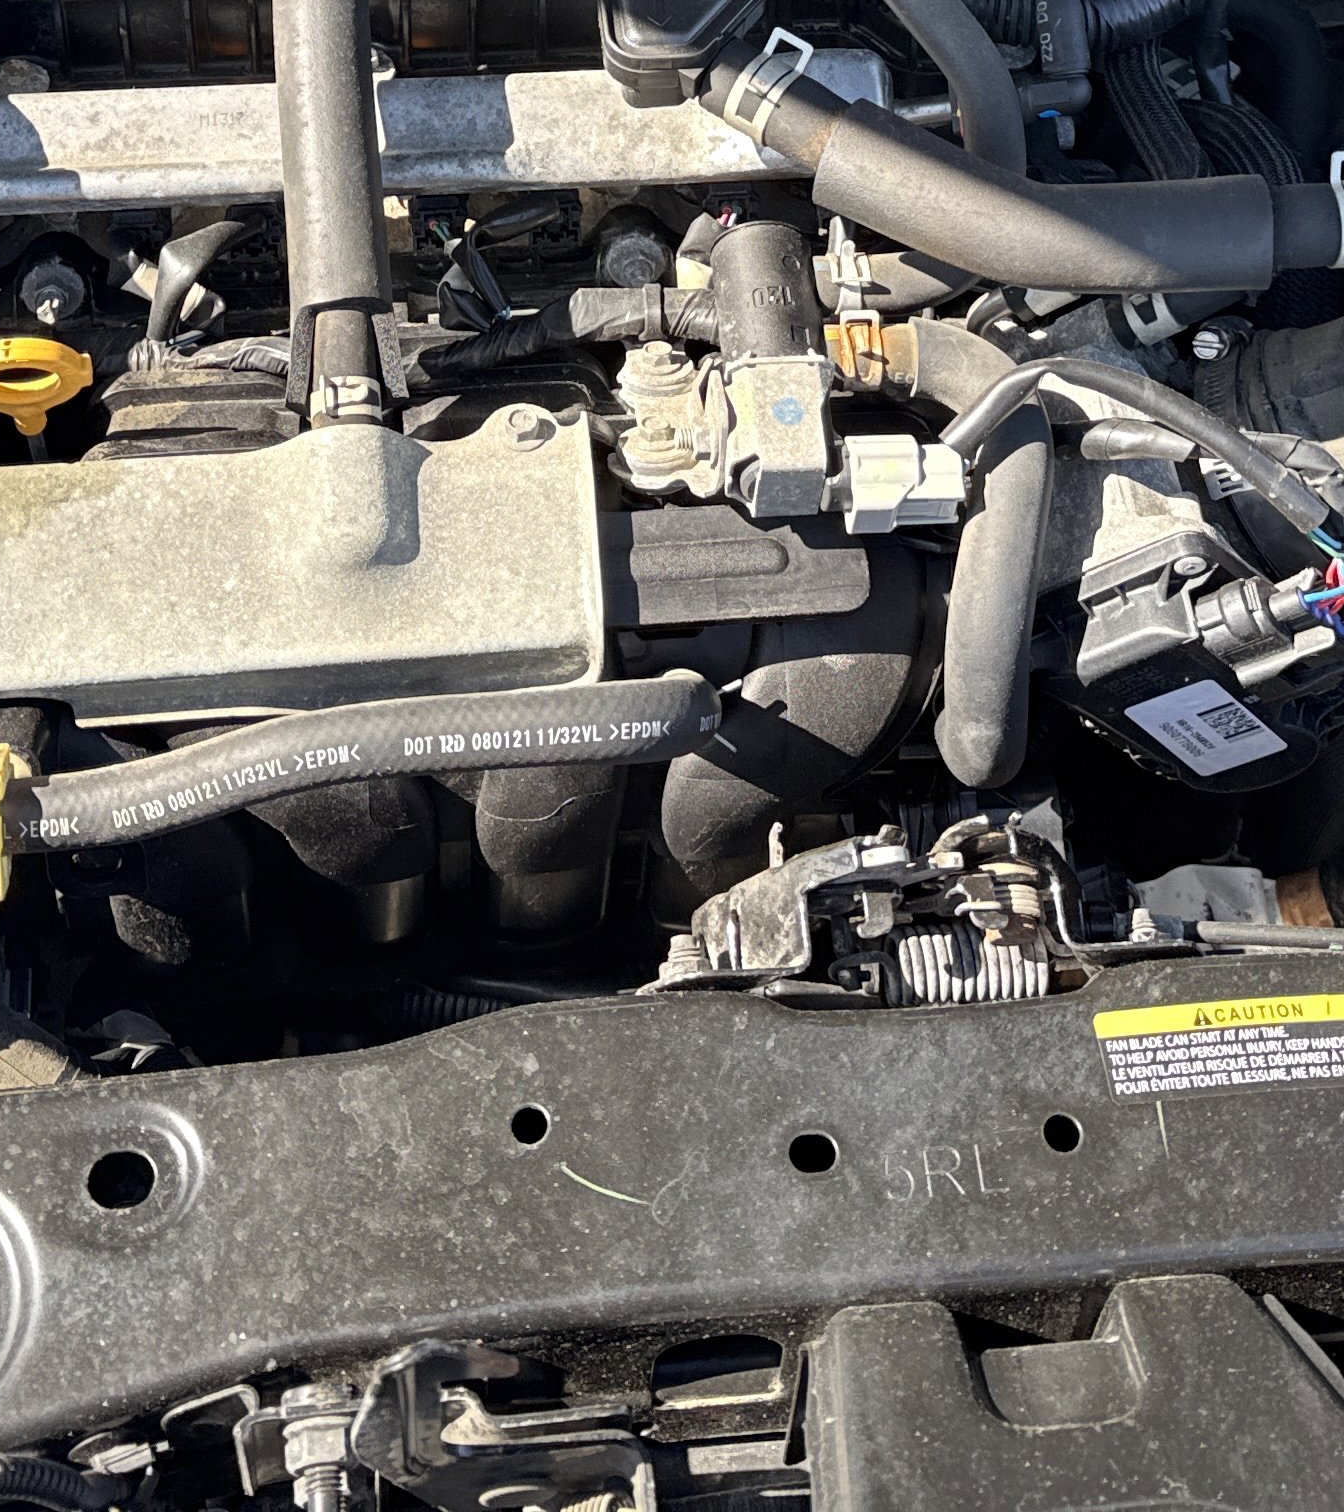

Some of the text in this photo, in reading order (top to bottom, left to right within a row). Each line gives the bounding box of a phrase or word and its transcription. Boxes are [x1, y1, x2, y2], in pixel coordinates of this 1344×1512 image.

[404, 736, 433, 756] DOT
[112, 807, 138, 829] DOT
[1214, 1002, 1304, 1023] CAUTION
[1106, 1025, 1289, 1053] FAN BLADE CAN START AT ANY TIME.
[1109, 1053, 1126, 1067] TO
[1127, 1050, 1154, 1065] HELP
[1155, 1047, 1189, 1062] AVOID
[1190, 1043, 1245, 1059] PERSONAL
[1285, 1038, 1310, 1052] KEEP
[1111, 1067, 1127, 1081] LE
[1127, 1061, 1205, 1080] VENTILATEUR
[1206, 1056, 1248, 1072] RISQUE
[1249, 1054, 1267, 1068] DE
[1267, 1048, 1330, 1066] DÉMARRER
[1331, 1048, 1341, 1062] À
[1115, 1079, 1150, 1095] POUR
[1150, 1074, 1191, 1093] ÉVITER
[1192, 1072, 1230, 1089] TOUTE
[1231, 1068, 1291, 1085] BLESSURE,
[1291, 1067, 1309, 1080] NE
[1309, 1065, 1331, 1078] PAS
